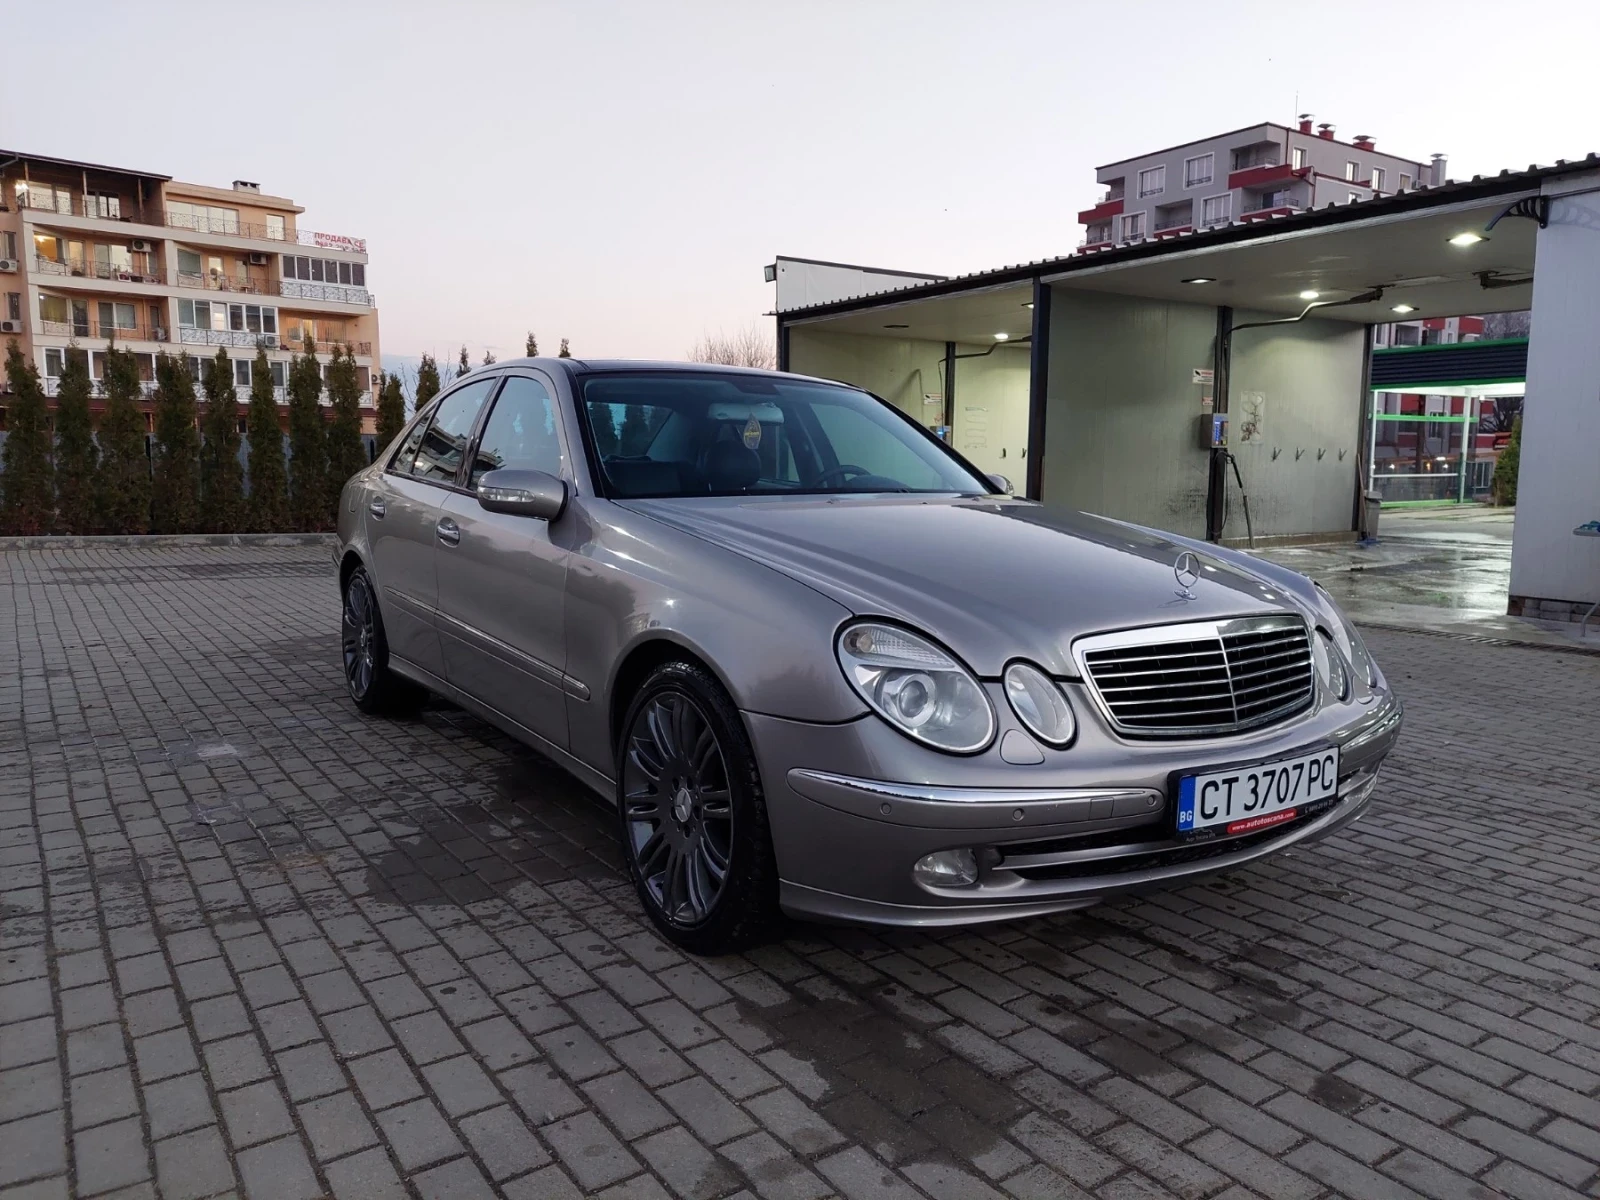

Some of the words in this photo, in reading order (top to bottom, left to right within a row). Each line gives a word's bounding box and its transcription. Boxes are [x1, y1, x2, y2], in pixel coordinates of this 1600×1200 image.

[1200, 776, 1239, 820] CT
[1244, 763, 1304, 811] 3707
[1308, 755, 1334, 797] PC
[1180, 811, 1192, 822] BG
[1232, 812, 1295, 831] www.autotoscana.com
